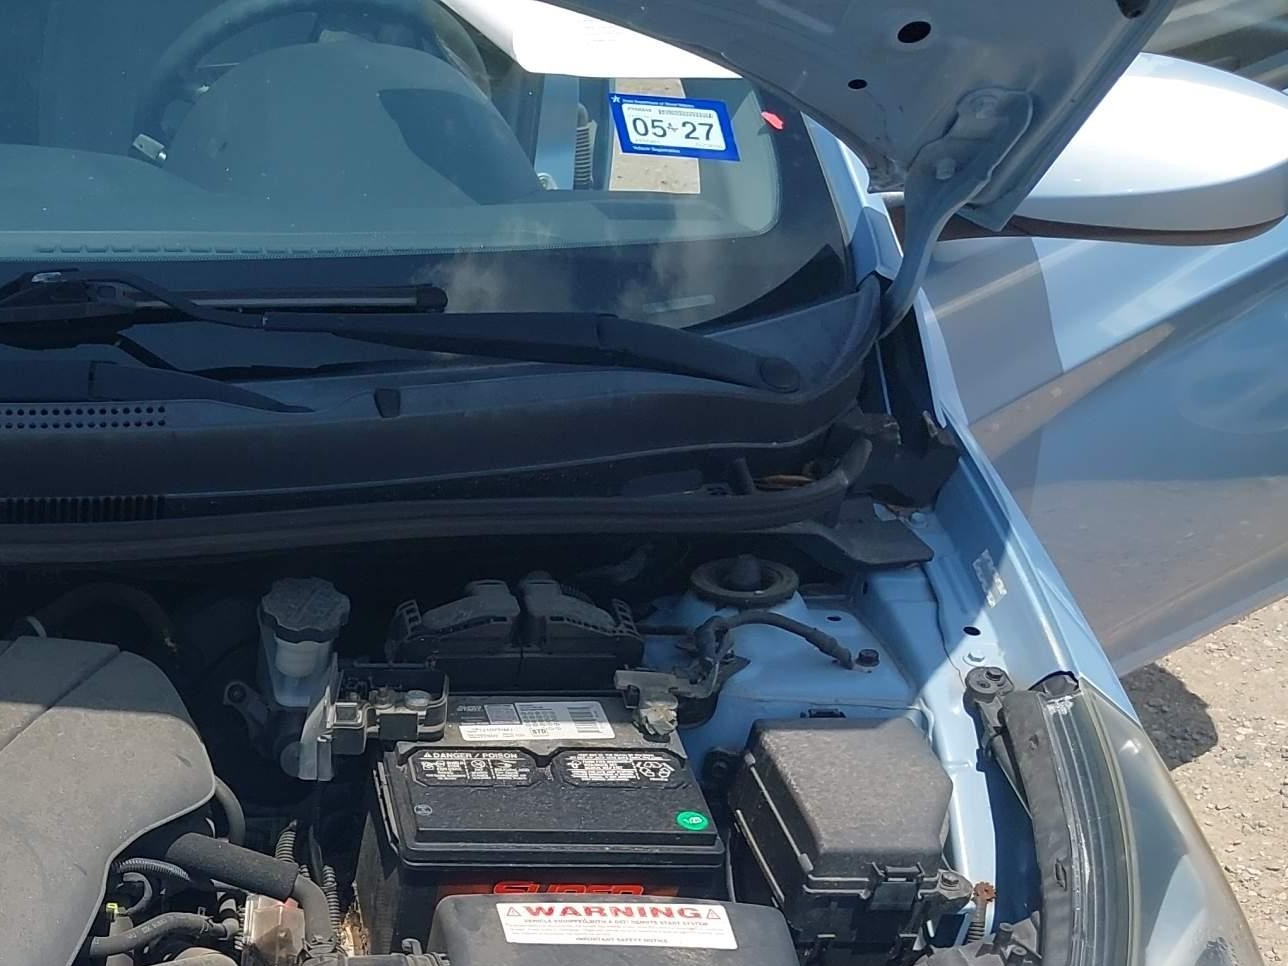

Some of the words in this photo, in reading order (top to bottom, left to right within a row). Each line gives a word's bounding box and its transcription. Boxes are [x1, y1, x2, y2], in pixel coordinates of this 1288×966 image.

[632, 117, 667, 138] 05
[681, 121, 714, 141] 27
[523, 905, 703, 919] WARNING
